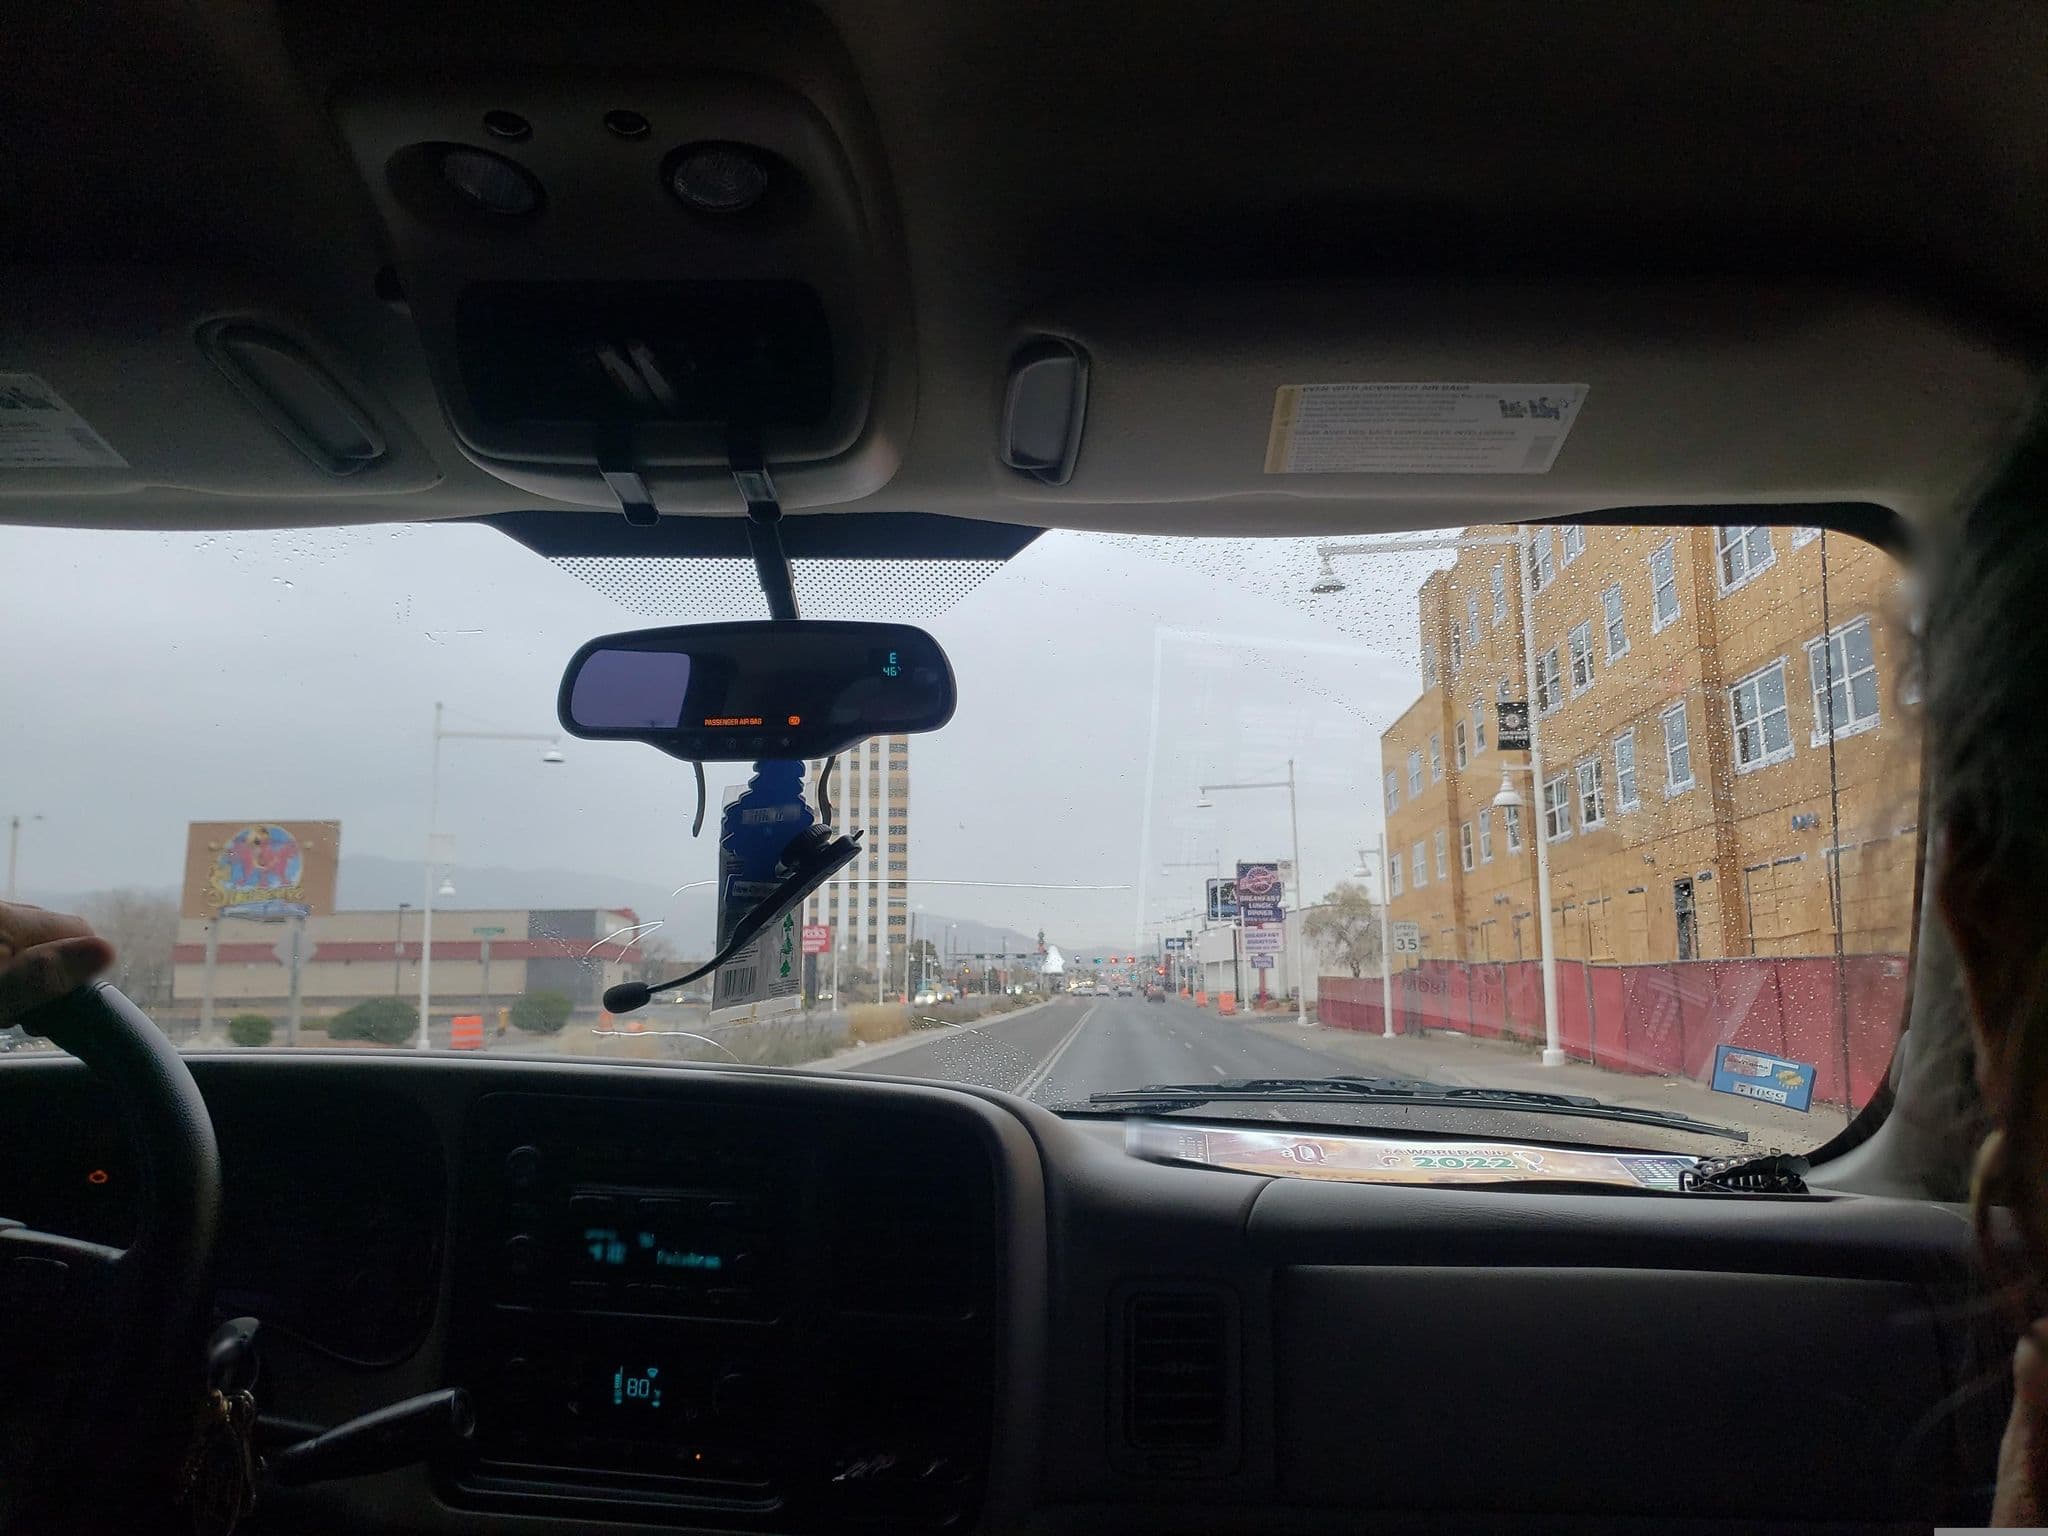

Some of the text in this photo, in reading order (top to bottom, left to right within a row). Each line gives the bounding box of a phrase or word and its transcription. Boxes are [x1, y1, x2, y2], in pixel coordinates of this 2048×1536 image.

[890, 652, 897, 664] E
[704, 718, 763, 726] PASSENGER AIR BAG
[1395, 938, 1417, 951] 35
[1406, 1149, 1469, 1157] WORLD
[1411, 1156, 1518, 1169] 2022
[626, 1377, 651, 1398] 80
